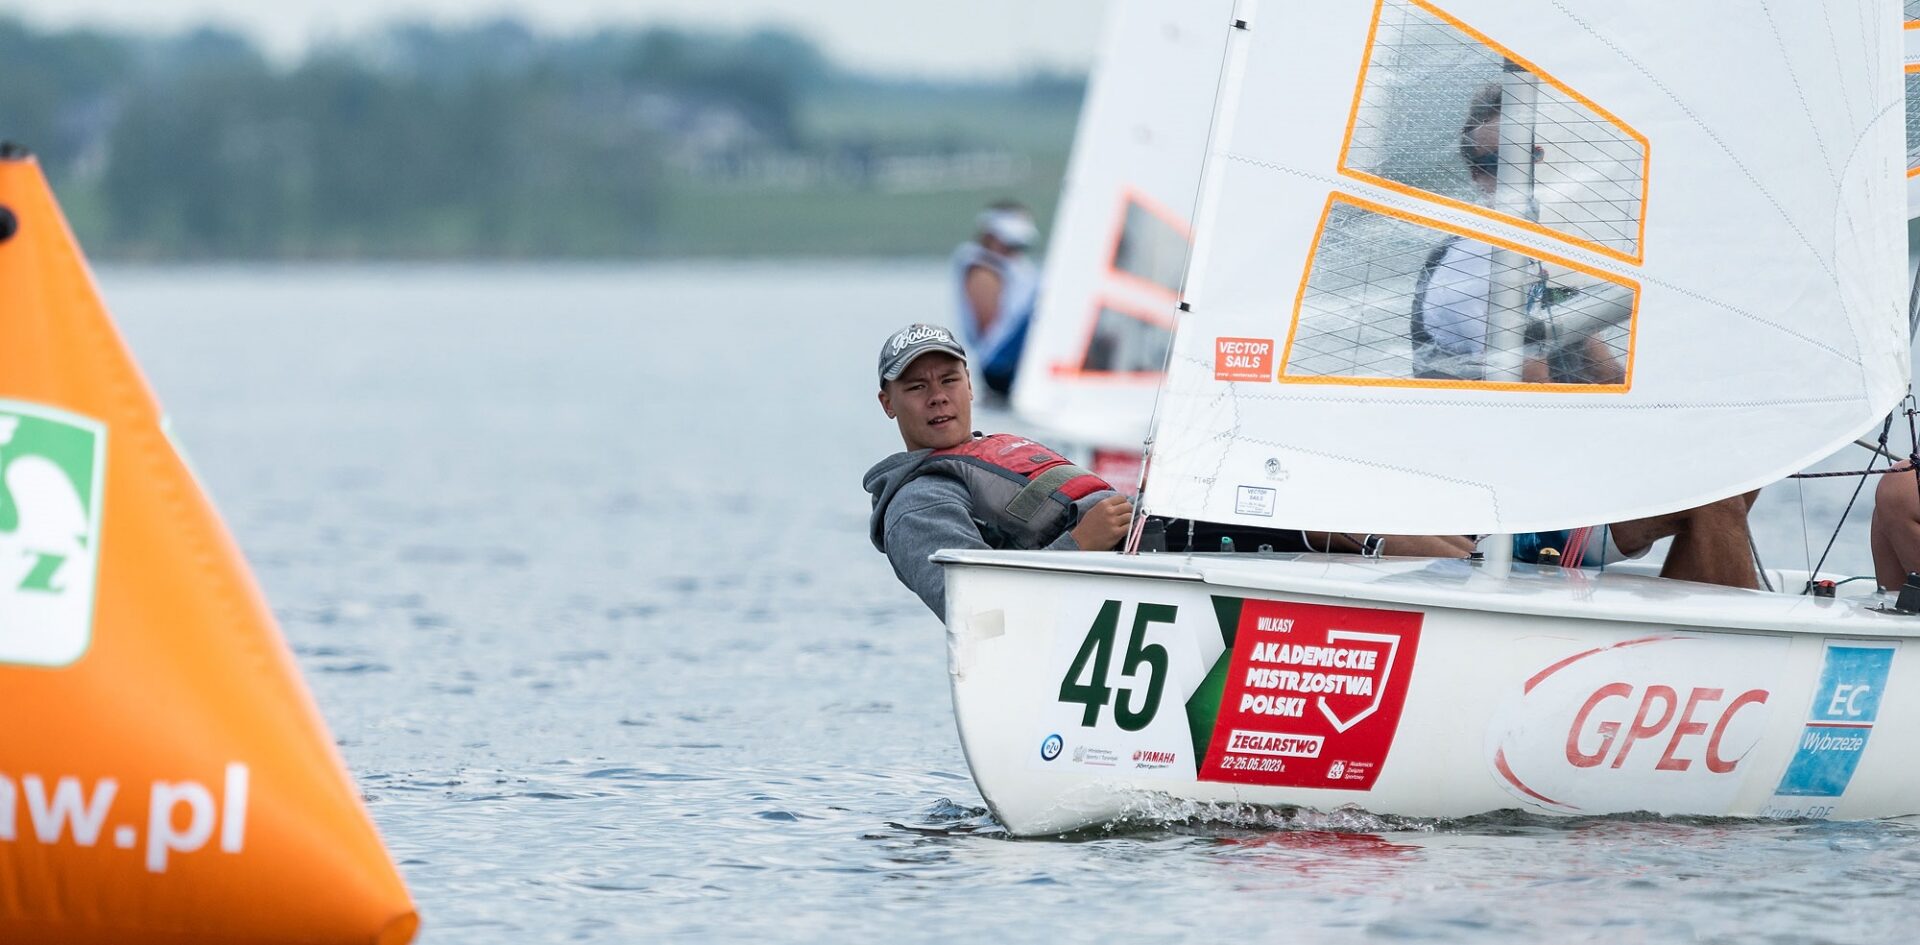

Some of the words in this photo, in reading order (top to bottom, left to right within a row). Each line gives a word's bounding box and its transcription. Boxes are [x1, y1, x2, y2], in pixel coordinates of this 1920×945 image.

[892, 326, 949, 356] Boston
[1219, 341, 1269, 355] VECTOR
[1225, 355, 1261, 368] SAILS
[1257, 616, 1295, 633] WILKASY
[1058, 599, 1179, 732] 45
[1250, 641, 1378, 670] AKADEMICKIE
[1245, 667, 1373, 696] MISTRZOSTWA
[1239, 693, 1307, 717] POLSKI
[1827, 684, 1871, 717] EC
[1565, 681, 1770, 774] GPEC
[1231, 732, 1318, 754] ŻEGLARSTWO
[1803, 732, 1863, 754] Wybrzeże
[1142, 750, 1176, 764] YAMAHA
